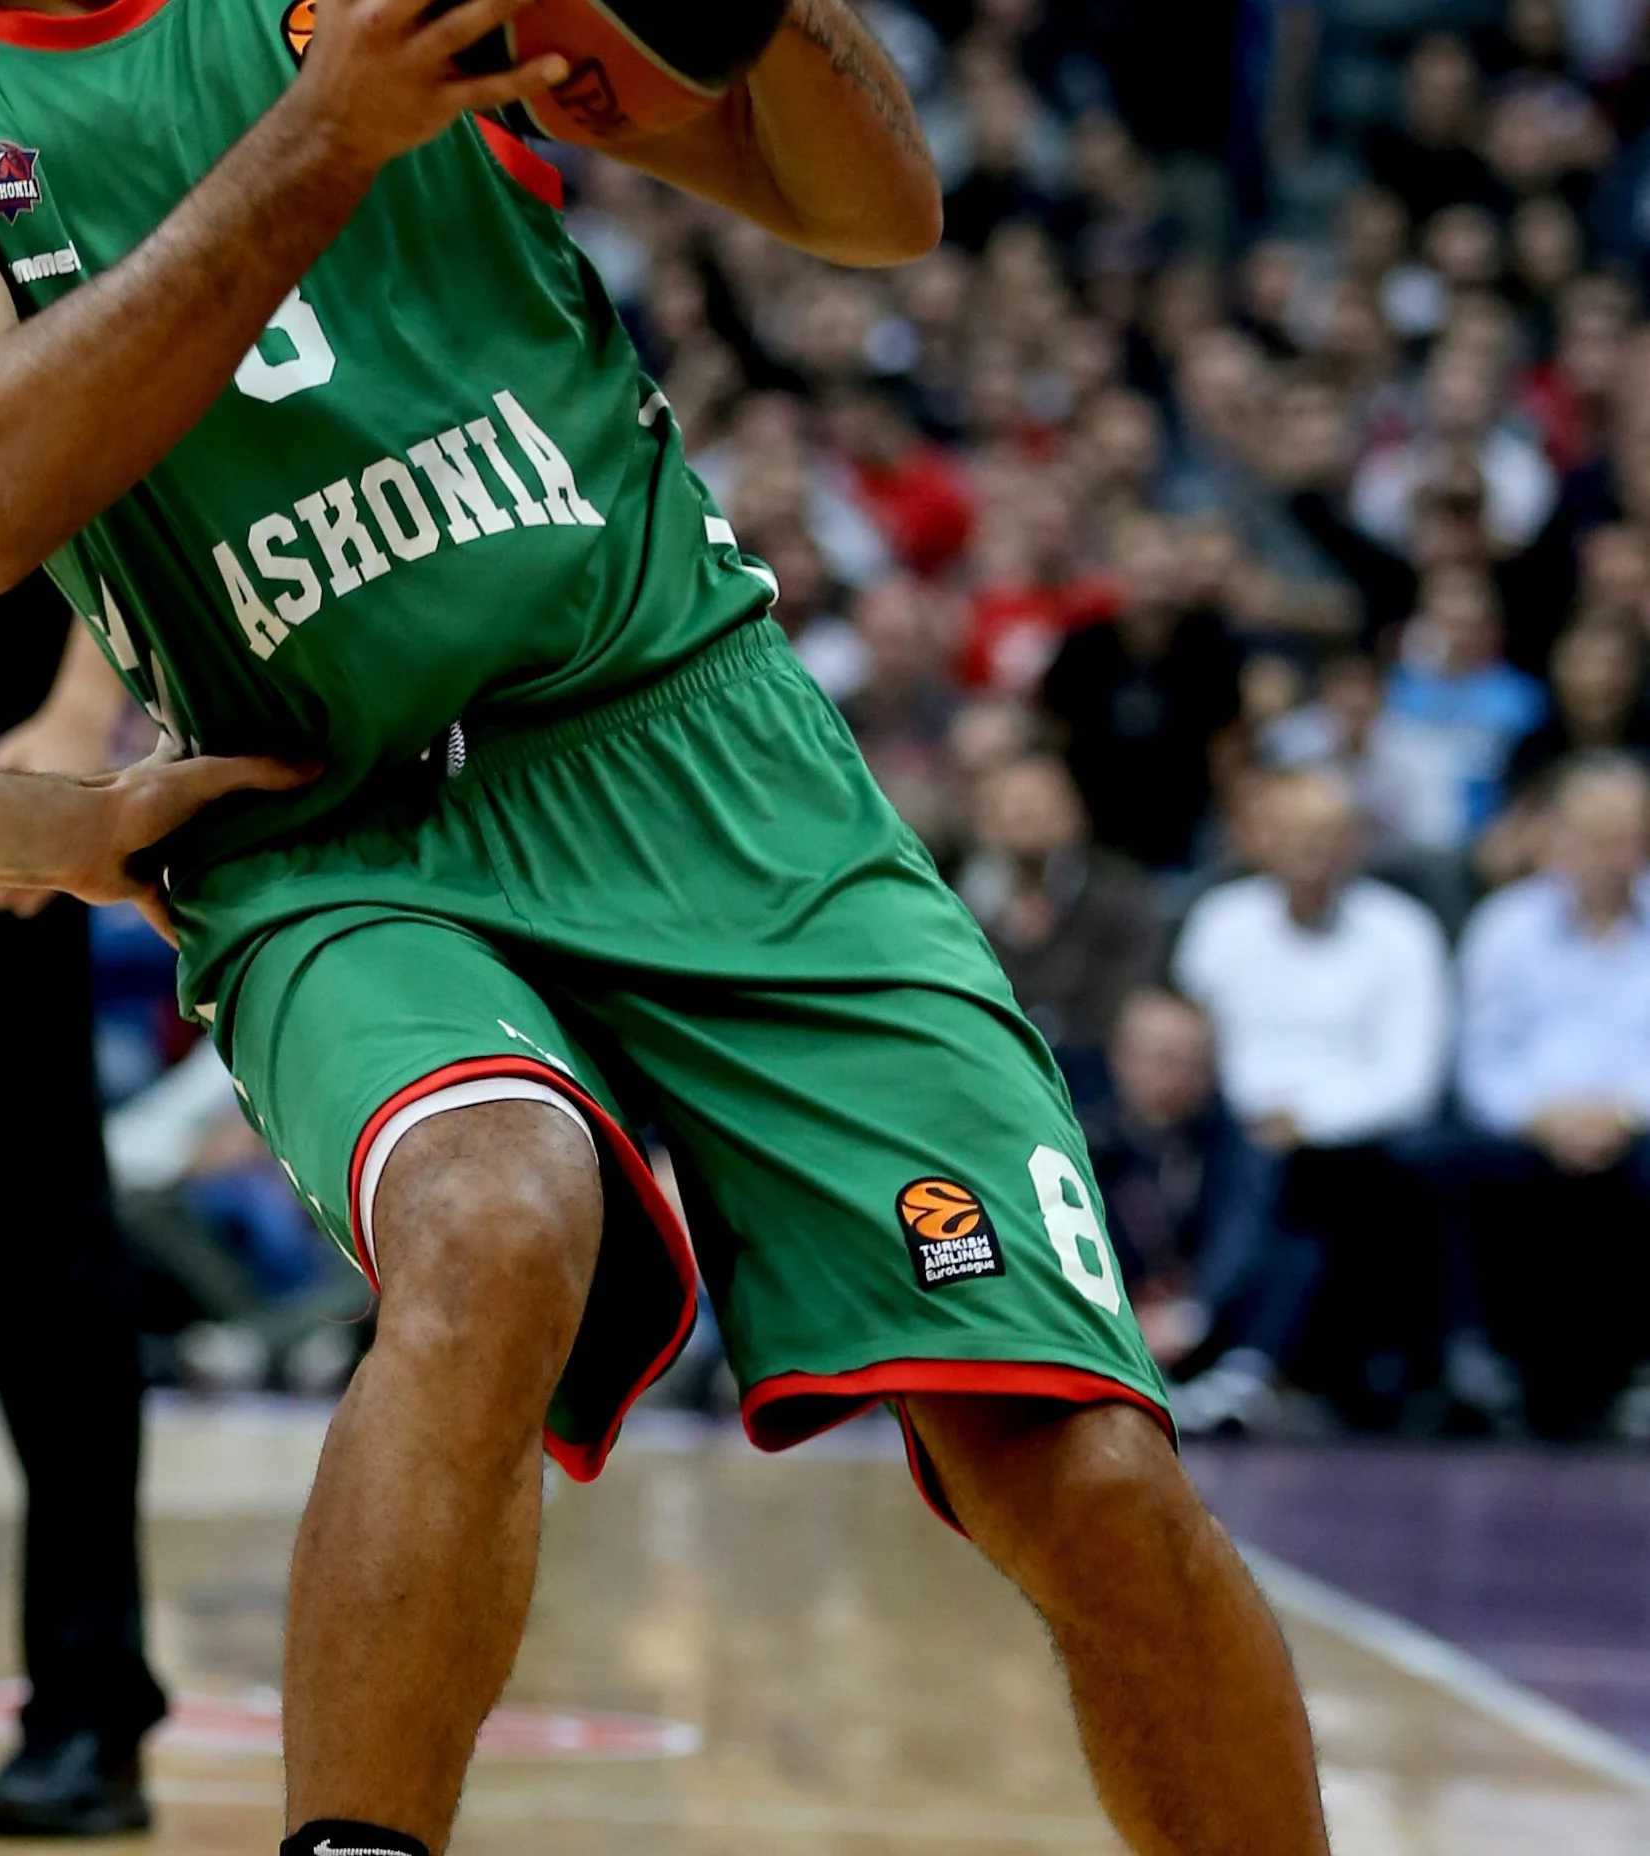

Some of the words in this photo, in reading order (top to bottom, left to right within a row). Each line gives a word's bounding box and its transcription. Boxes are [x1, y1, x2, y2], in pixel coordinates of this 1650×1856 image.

[10, 240, 82, 284] mmel
[212, 389, 606, 661] ASKONIA
[919, 1235, 989, 1258] TURKISH
[1027, 1144, 1120, 1316] 8
[924, 1246, 993, 1271] AIRLINES
[926, 1259, 996, 1283] EuroLeague
